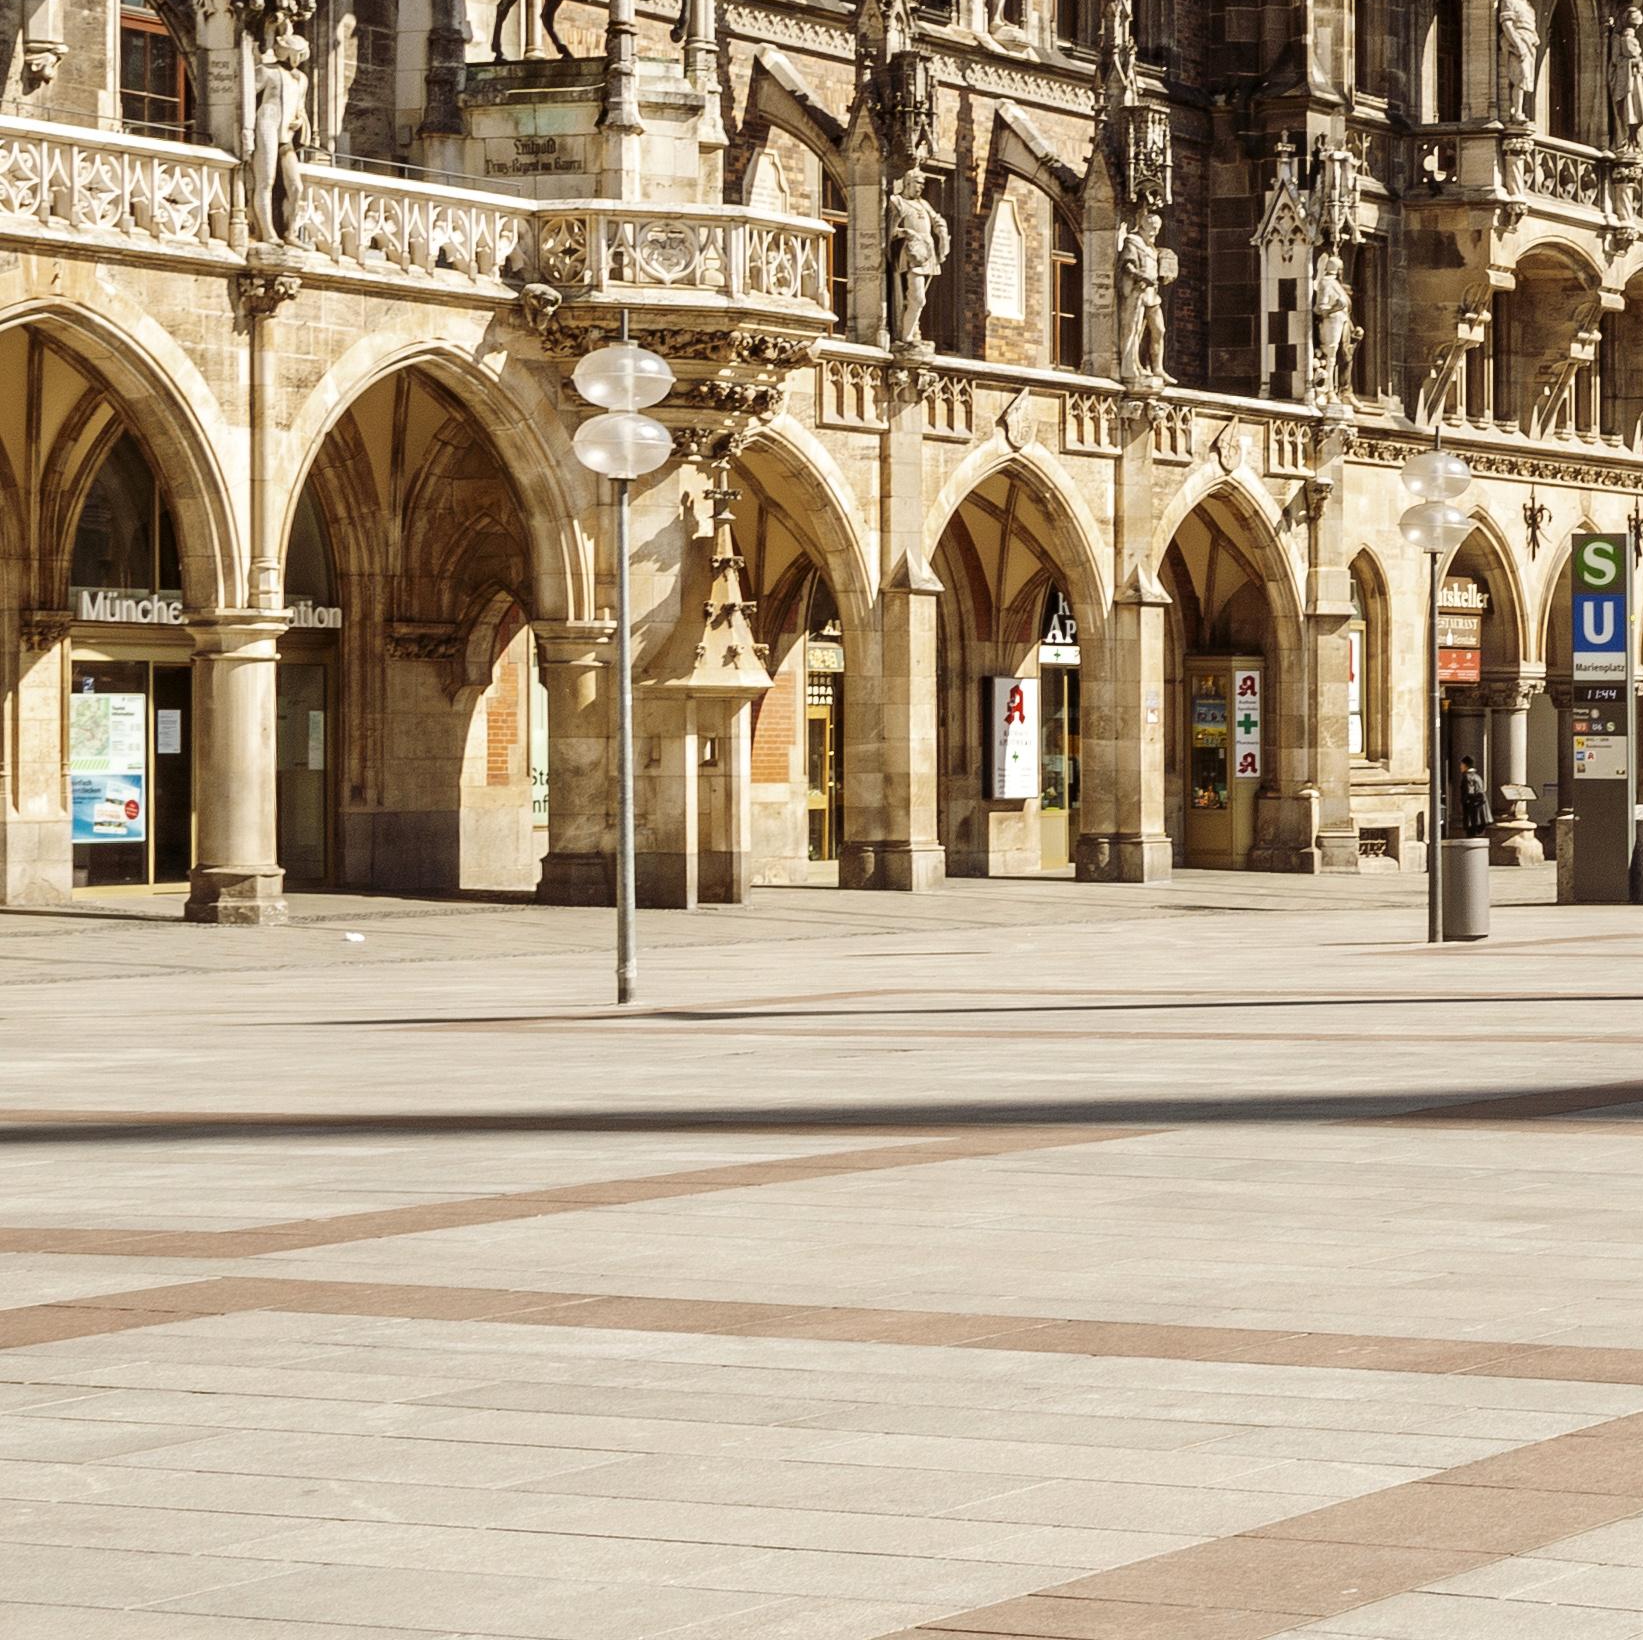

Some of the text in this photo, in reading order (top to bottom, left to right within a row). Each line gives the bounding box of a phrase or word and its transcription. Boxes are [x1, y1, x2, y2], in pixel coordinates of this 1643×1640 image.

[1583, 541, 1616, 586] S
[81, 590, 189, 625] Münche
[1583, 600, 1615, 645] U
[1575, 662, 1625, 674] Marienplatz
